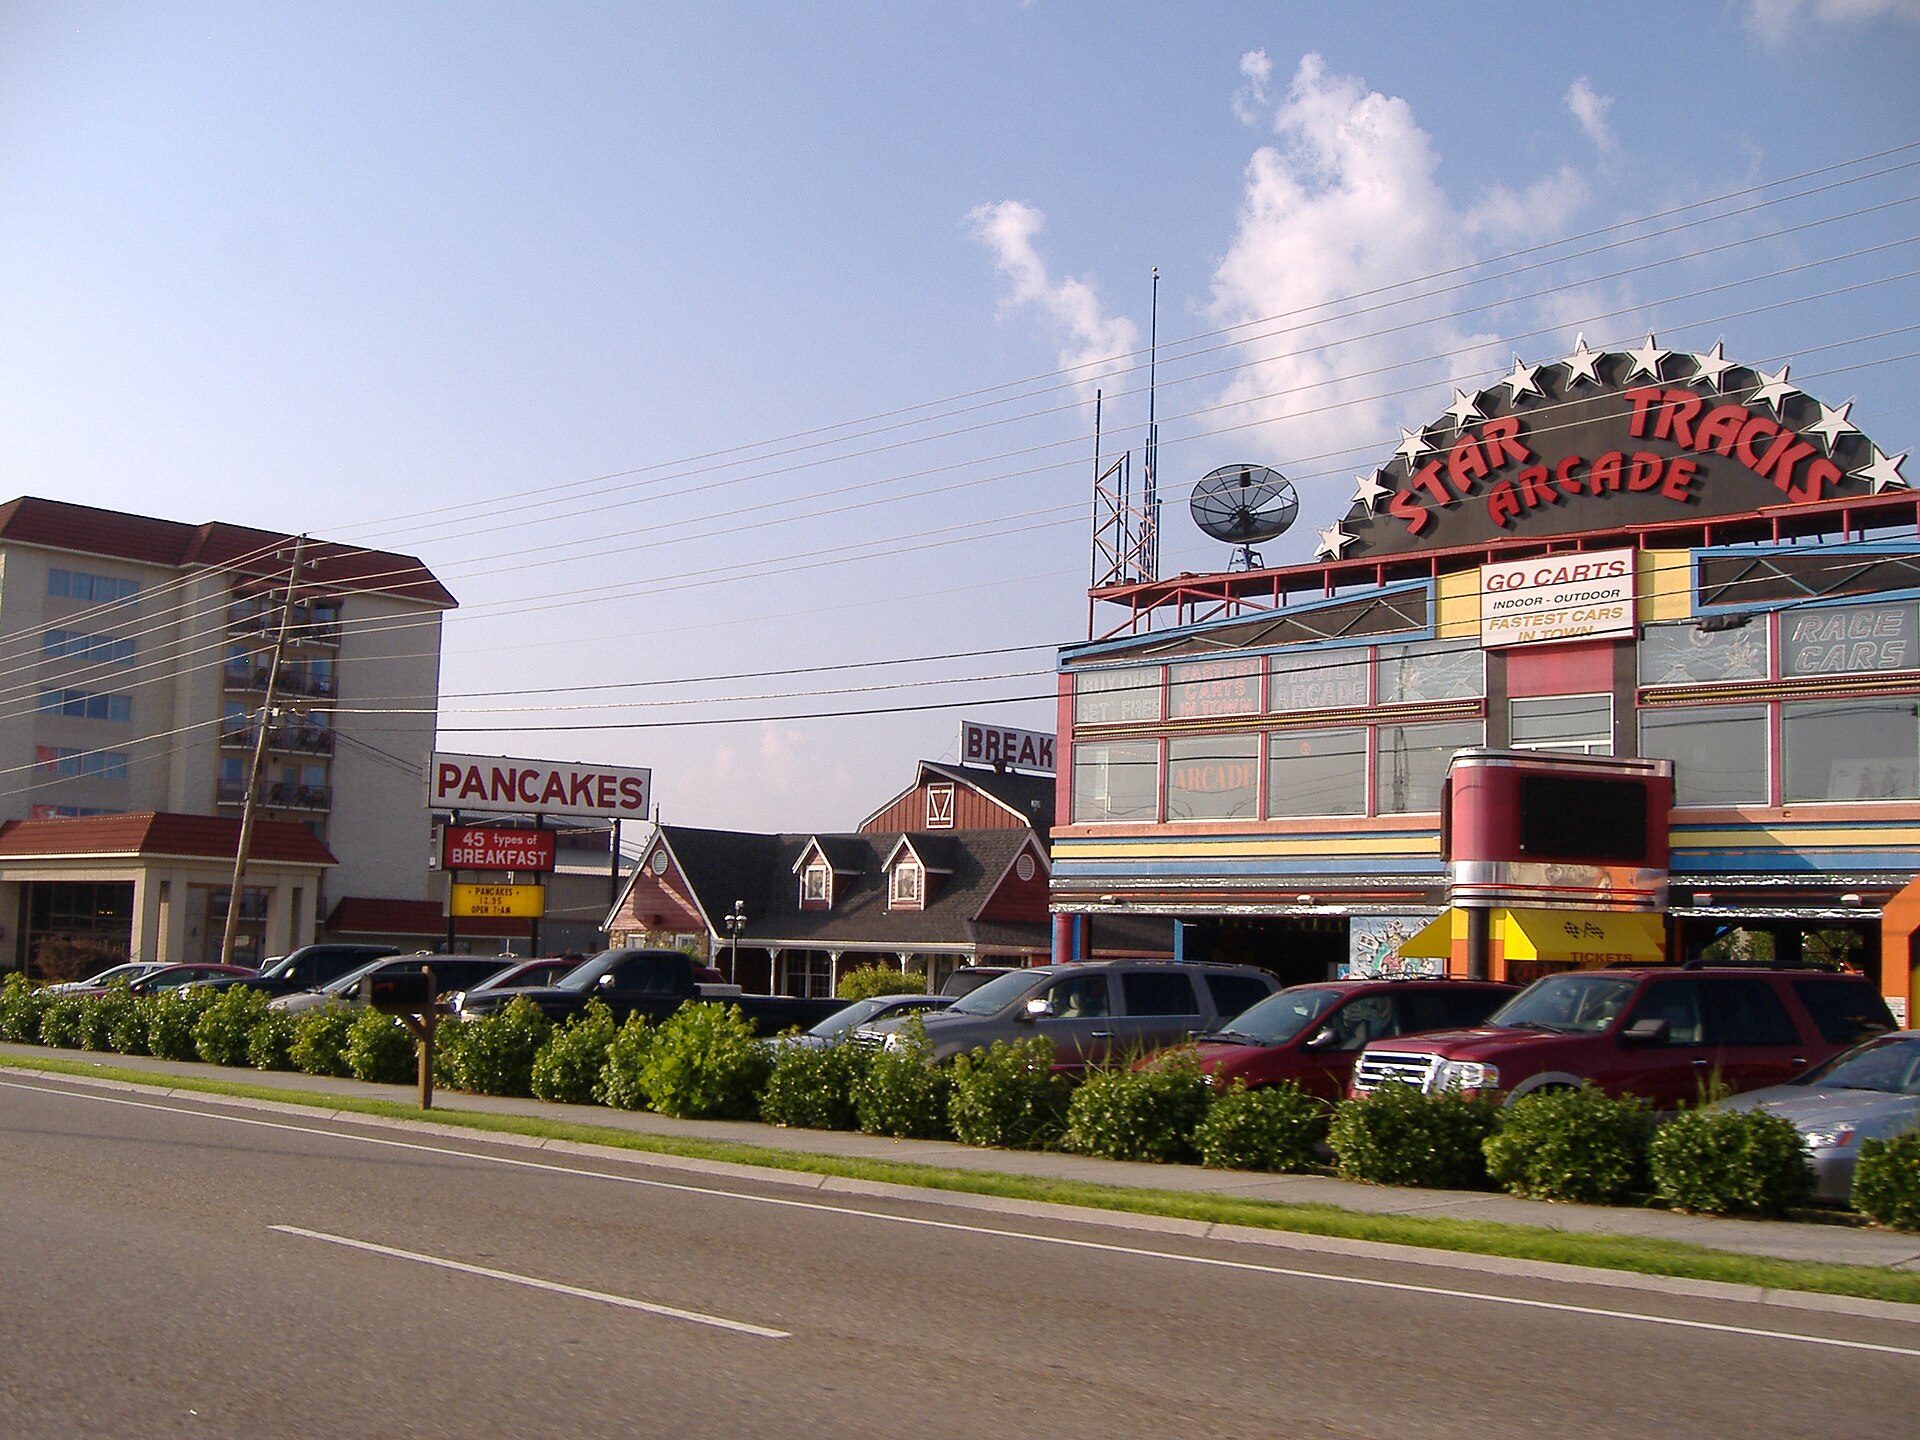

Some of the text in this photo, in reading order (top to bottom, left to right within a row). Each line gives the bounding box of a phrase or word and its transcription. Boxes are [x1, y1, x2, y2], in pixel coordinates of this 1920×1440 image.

[1389, 388, 1843, 536] STAR TRACKS
[1487, 451, 1699, 527] ARCADE
[1487, 560, 1625, 591] GO CARTS
[1493, 596, 1543, 610] INDOOR
[1554, 589, 1621, 604] OUTDOOR
[1489, 607, 1624, 631] FASTEST CARS
[1792, 609, 1904, 643] RACE
[1518, 631, 1535, 643] IN
[1795, 639, 1907, 672] CARS
[1184, 679, 1246, 699] CARTS
[1276, 680, 1366, 708] ARCADE
[968, 727, 1053, 768] BREAK
[438, 763, 643, 810] PANCAKES
[1175, 763, 1256, 792] ARCADE
[463, 831, 537, 848] 45 types of
[452, 848, 547, 866] BREAKFAST
[475, 887, 513, 896] PANCAKES
[471, 905, 489, 914] OPEN
[1570, 951, 1633, 963] TICKETS
